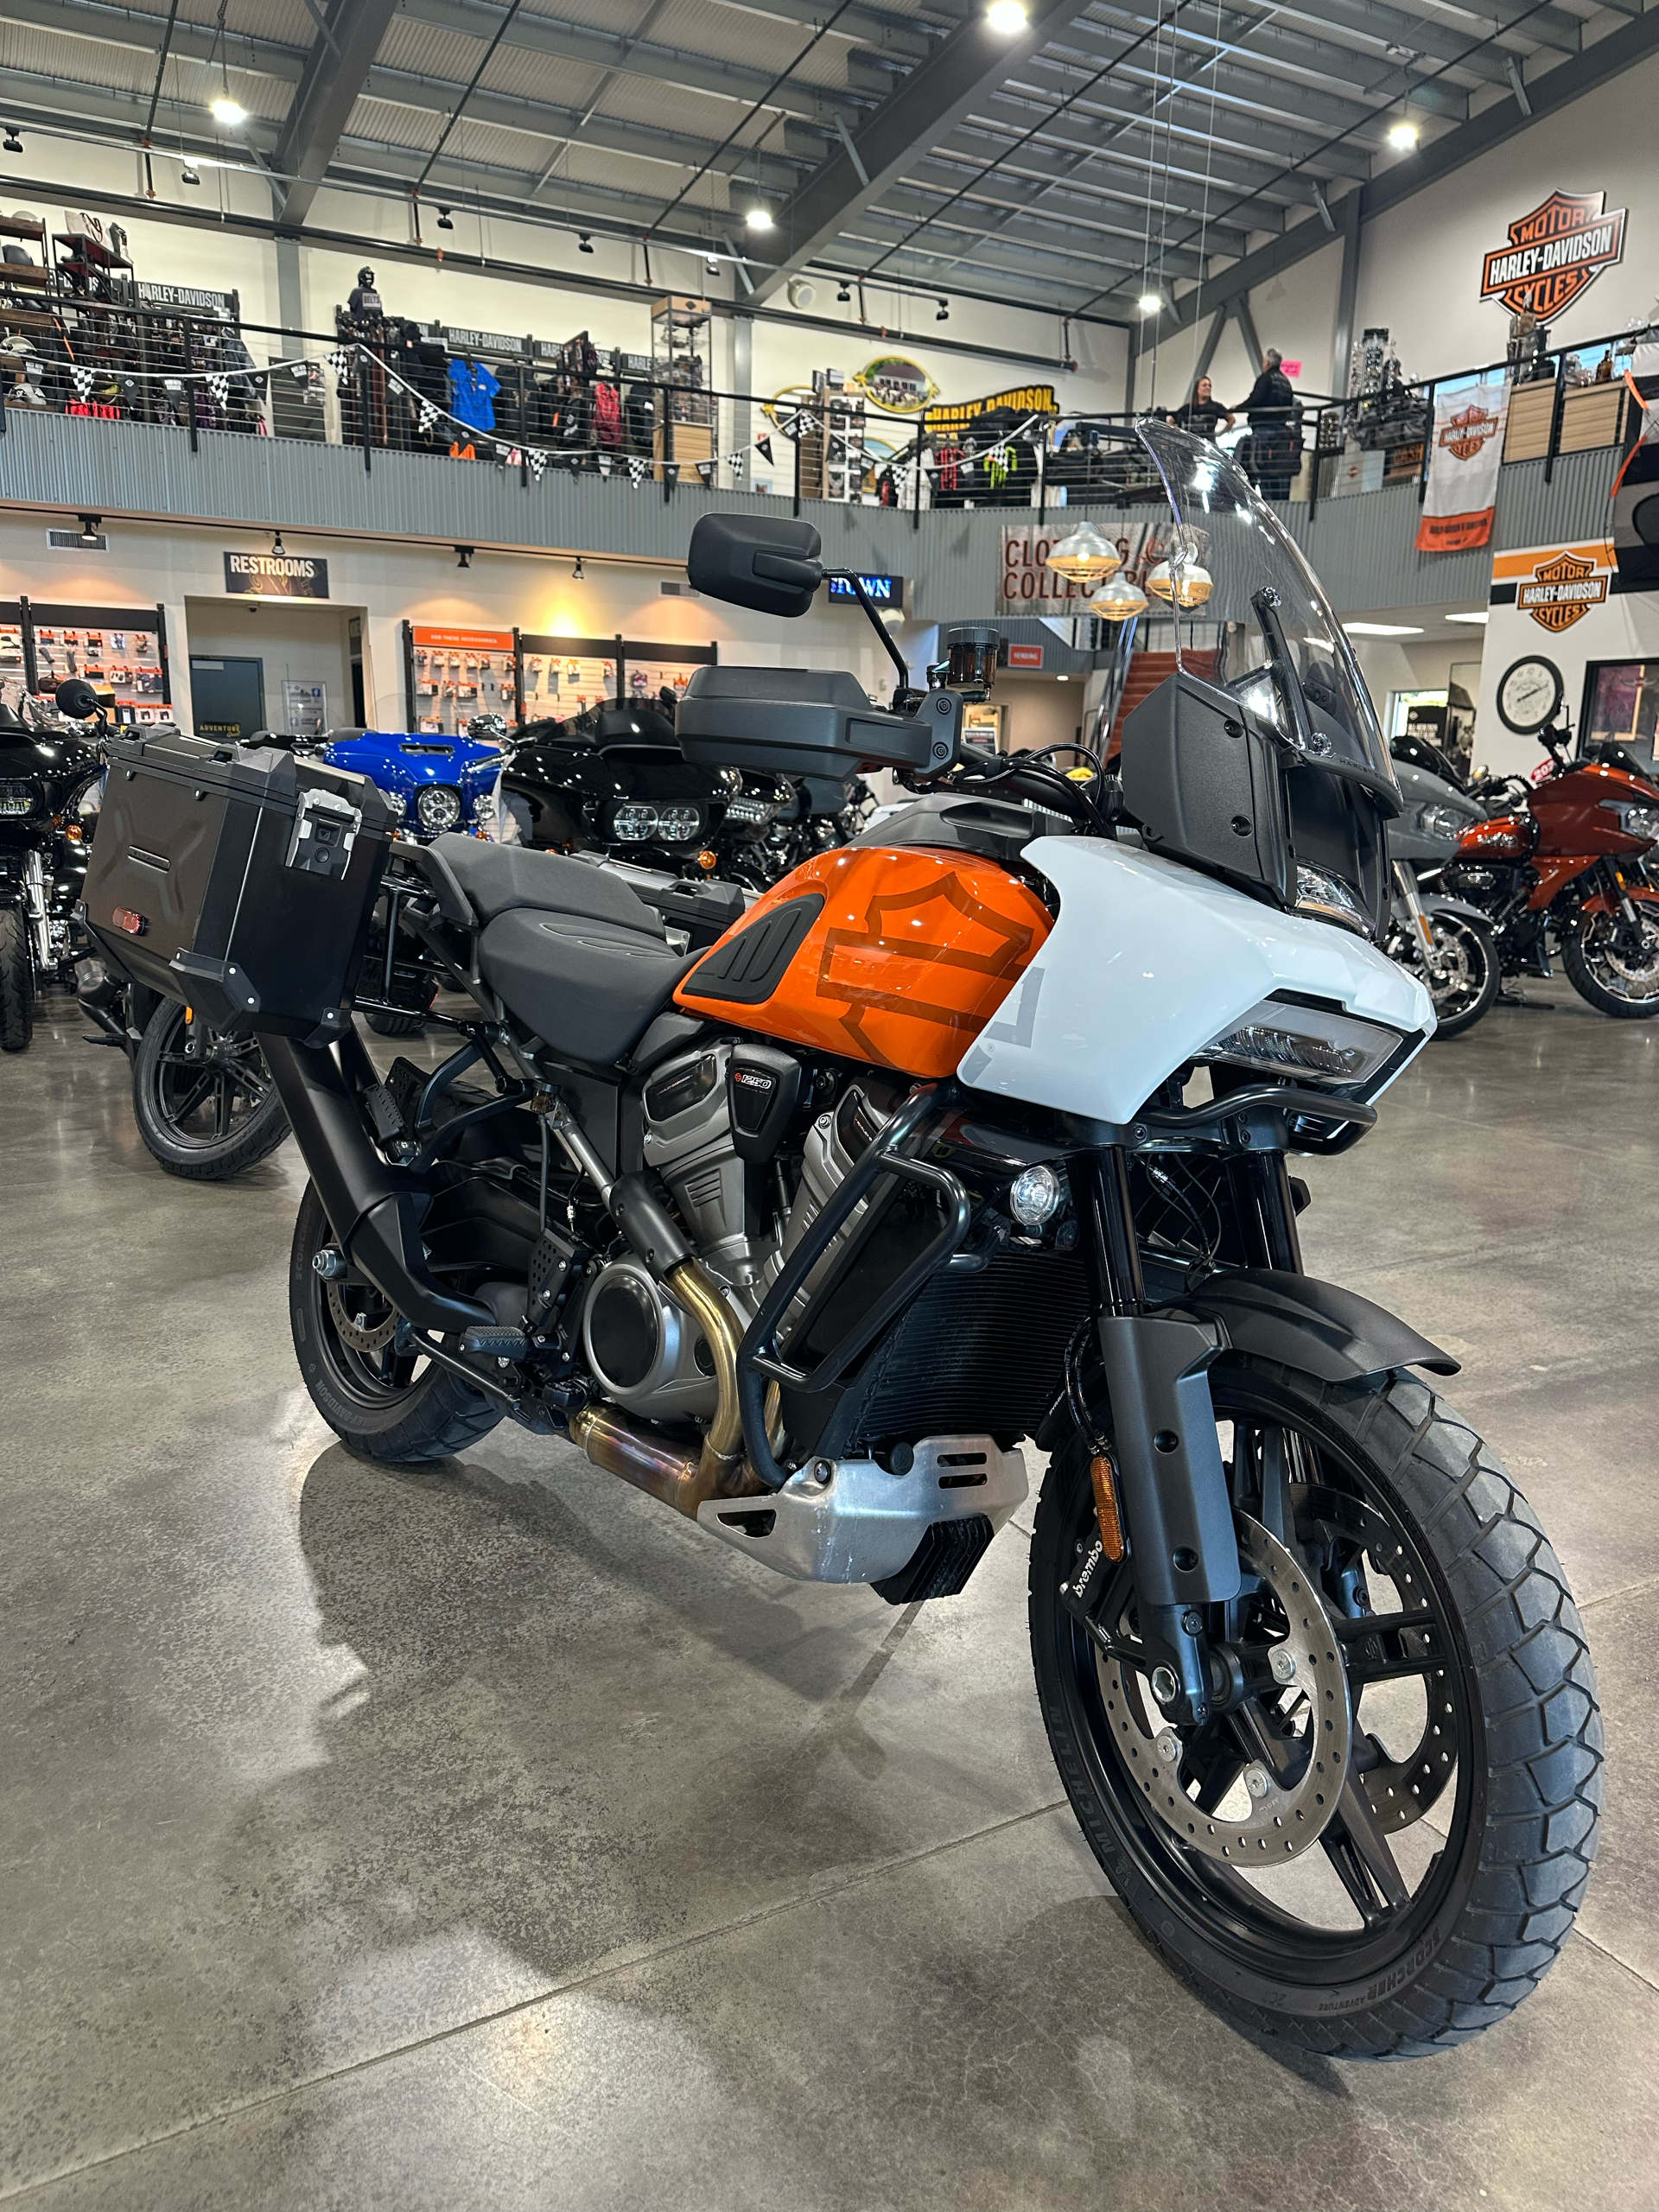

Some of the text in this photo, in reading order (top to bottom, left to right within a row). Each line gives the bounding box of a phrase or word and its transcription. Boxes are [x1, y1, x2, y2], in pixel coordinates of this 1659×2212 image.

[1520, 203, 1586, 244] MOTOR
[1489, 224, 1613, 287] HARLEY-DAVIDSON
[137, 282, 226, 308] HARLEY-DAVIDSON
[1513, 270, 1579, 313] CYCLES
[448, 327, 524, 353] HARLEY-DAVIDSON
[230, 555, 315, 578] RESTROOMS
[1542, 563, 1585, 582] MOTOR
[1522, 581, 1602, 604] HARLEY-DAVIDSON
[1538, 605, 1580, 626] CYCLES
[742, 1074, 772, 1089] 1250
[1072, 1540, 1103, 1598] brembo
[1049, 1706, 1116, 1854] MICHELIN
[1367, 1926, 1440, 2001] SCORCHER
[1318, 1995, 1366, 2012] ADVENTURE
